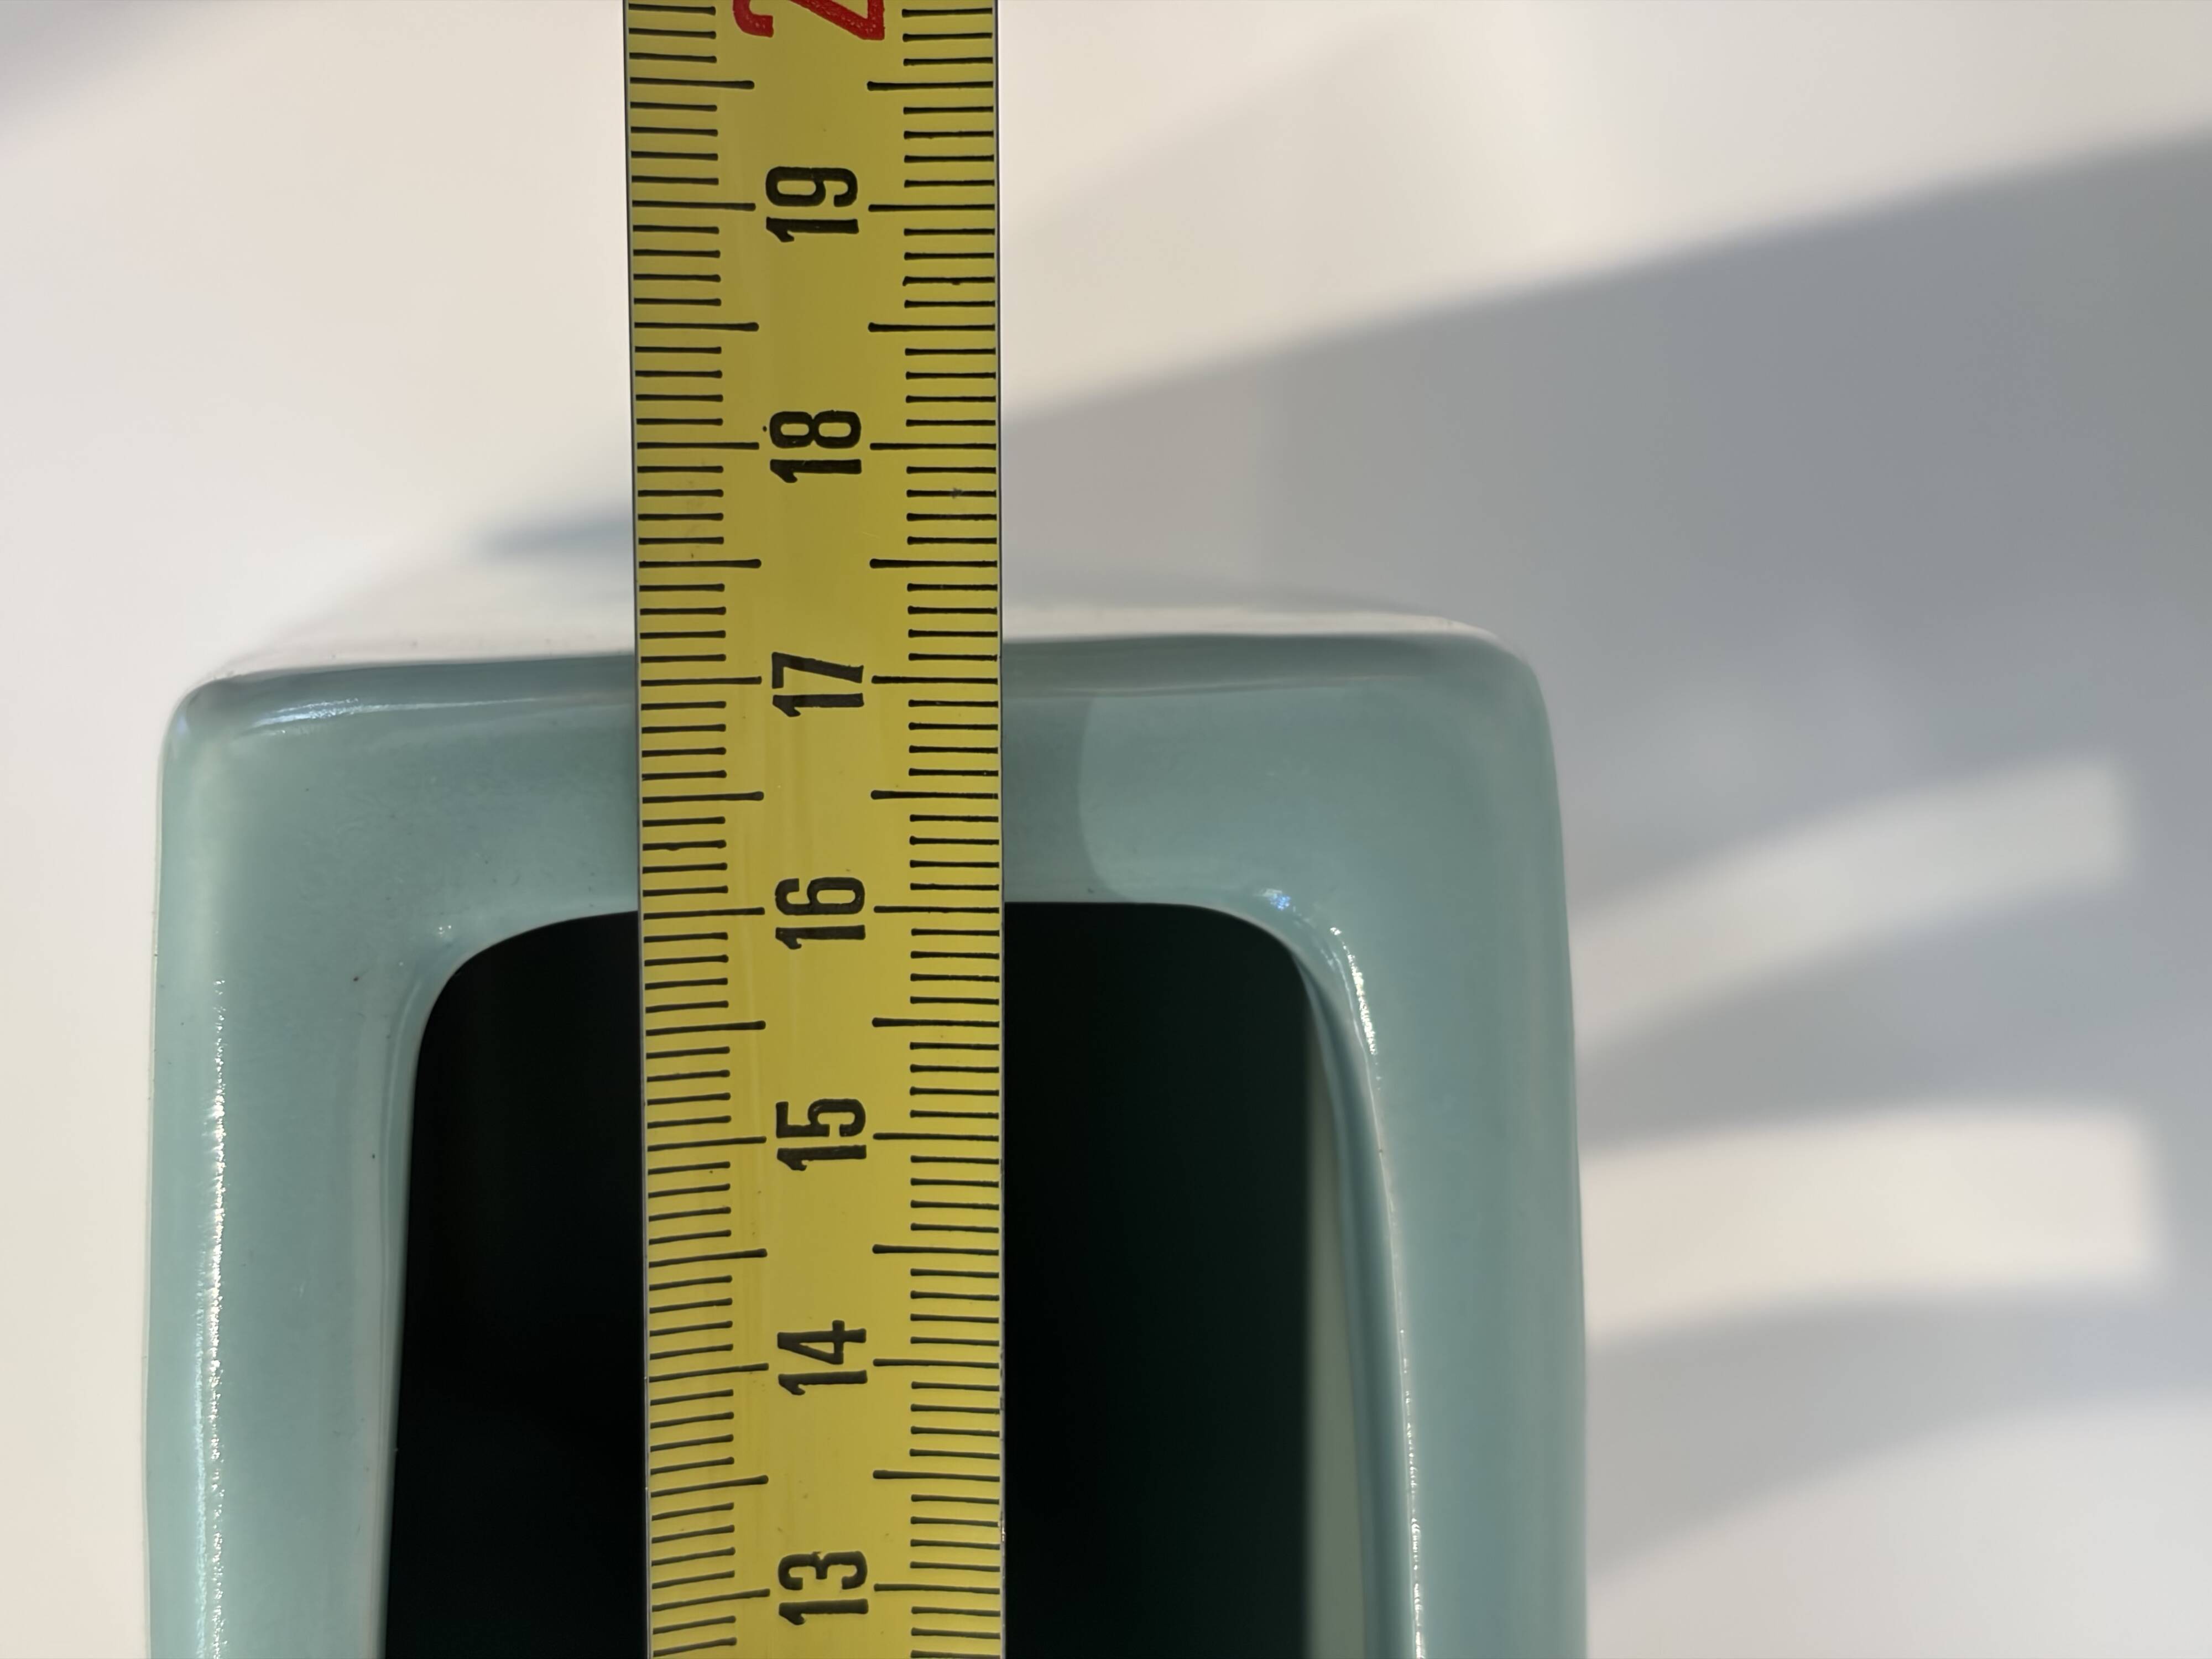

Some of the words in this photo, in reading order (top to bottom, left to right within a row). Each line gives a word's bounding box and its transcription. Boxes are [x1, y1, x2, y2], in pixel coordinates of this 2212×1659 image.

[765, 166, 859, 242] 19
[769, 410, 862, 483] 18
[771, 652, 864, 717] 17
[775, 877, 865, 950] 16
[776, 1099, 867, 1171] 15
[778, 1320, 868, 1395] 14
[778, 1552, 868, 1625] 13
